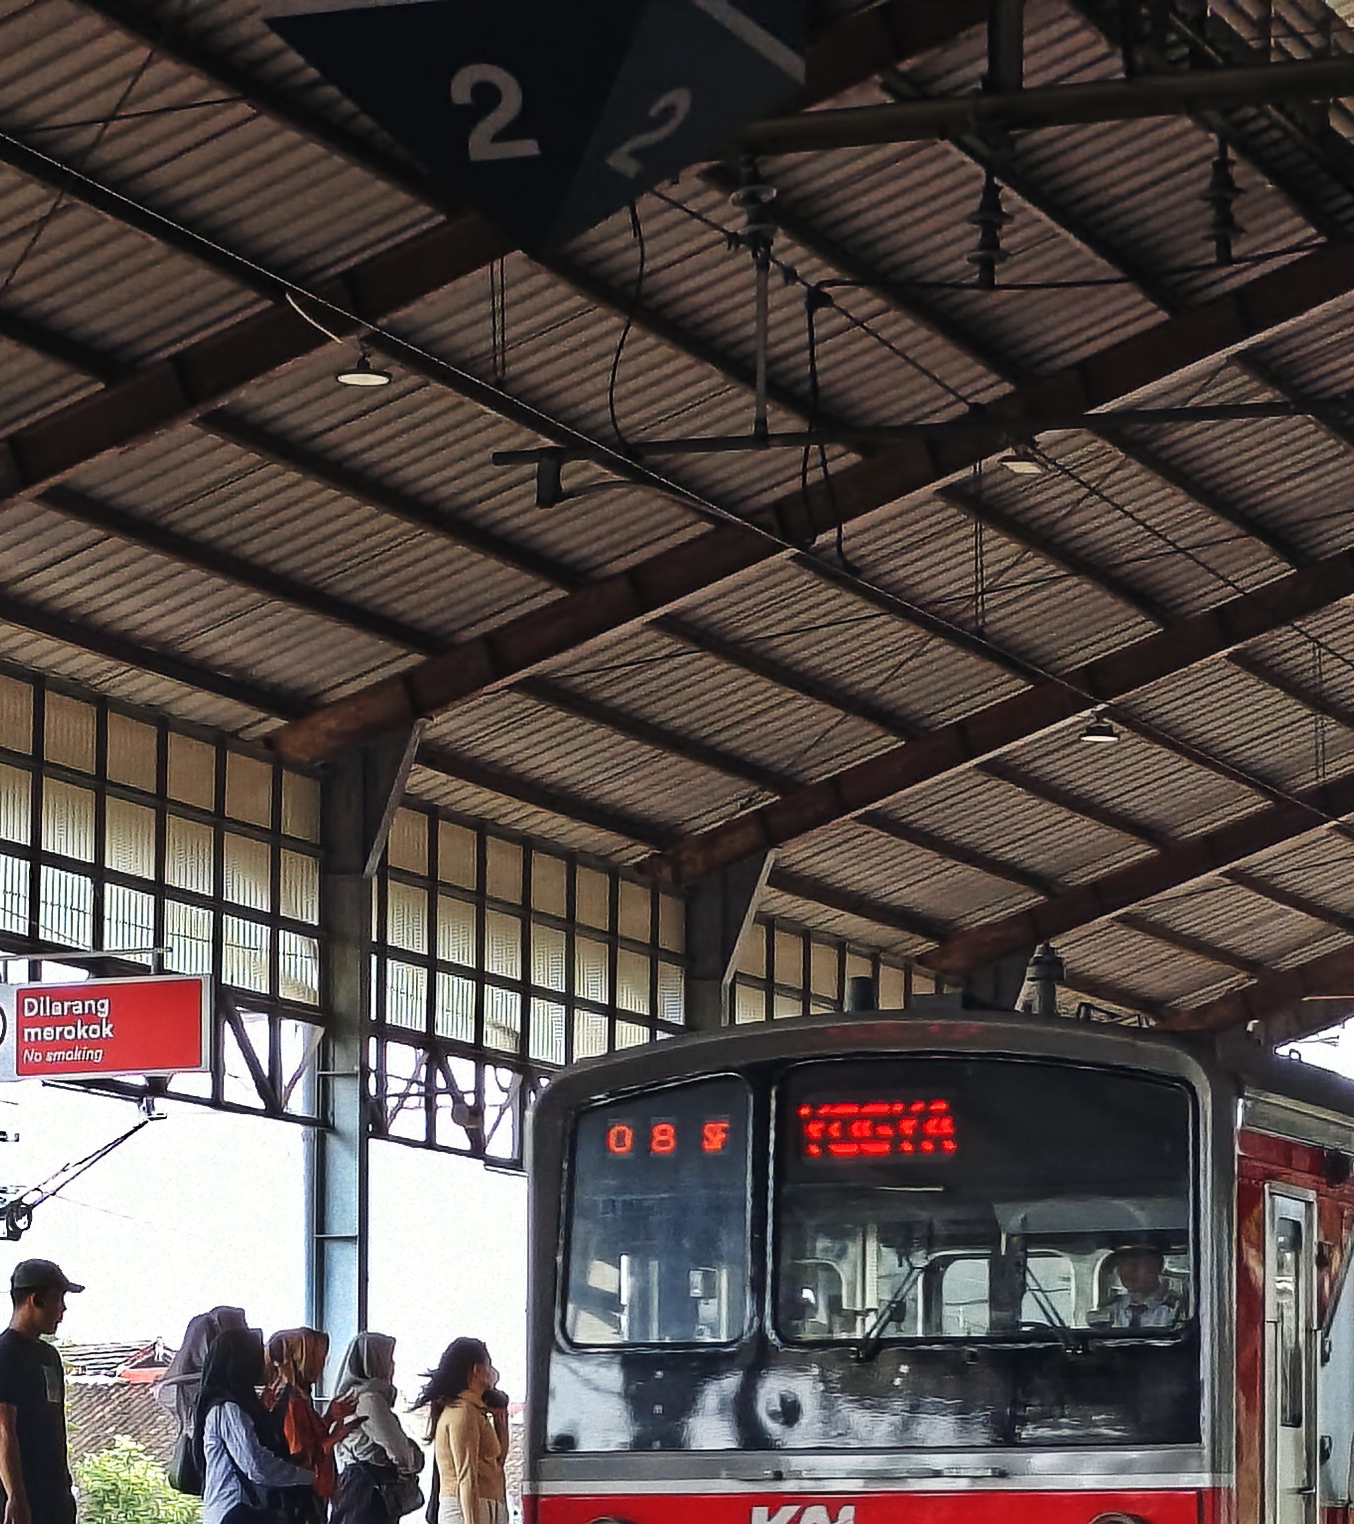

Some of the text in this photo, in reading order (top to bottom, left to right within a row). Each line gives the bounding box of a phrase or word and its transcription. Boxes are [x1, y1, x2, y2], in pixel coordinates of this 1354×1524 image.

[451, 63, 540, 161] 2
[606, 87, 692, 179] 2
[23, 996, 110, 1018] Dilarang
[24, 1018, 114, 1042] merokok
[23, 1046, 103, 1064] No smoking
